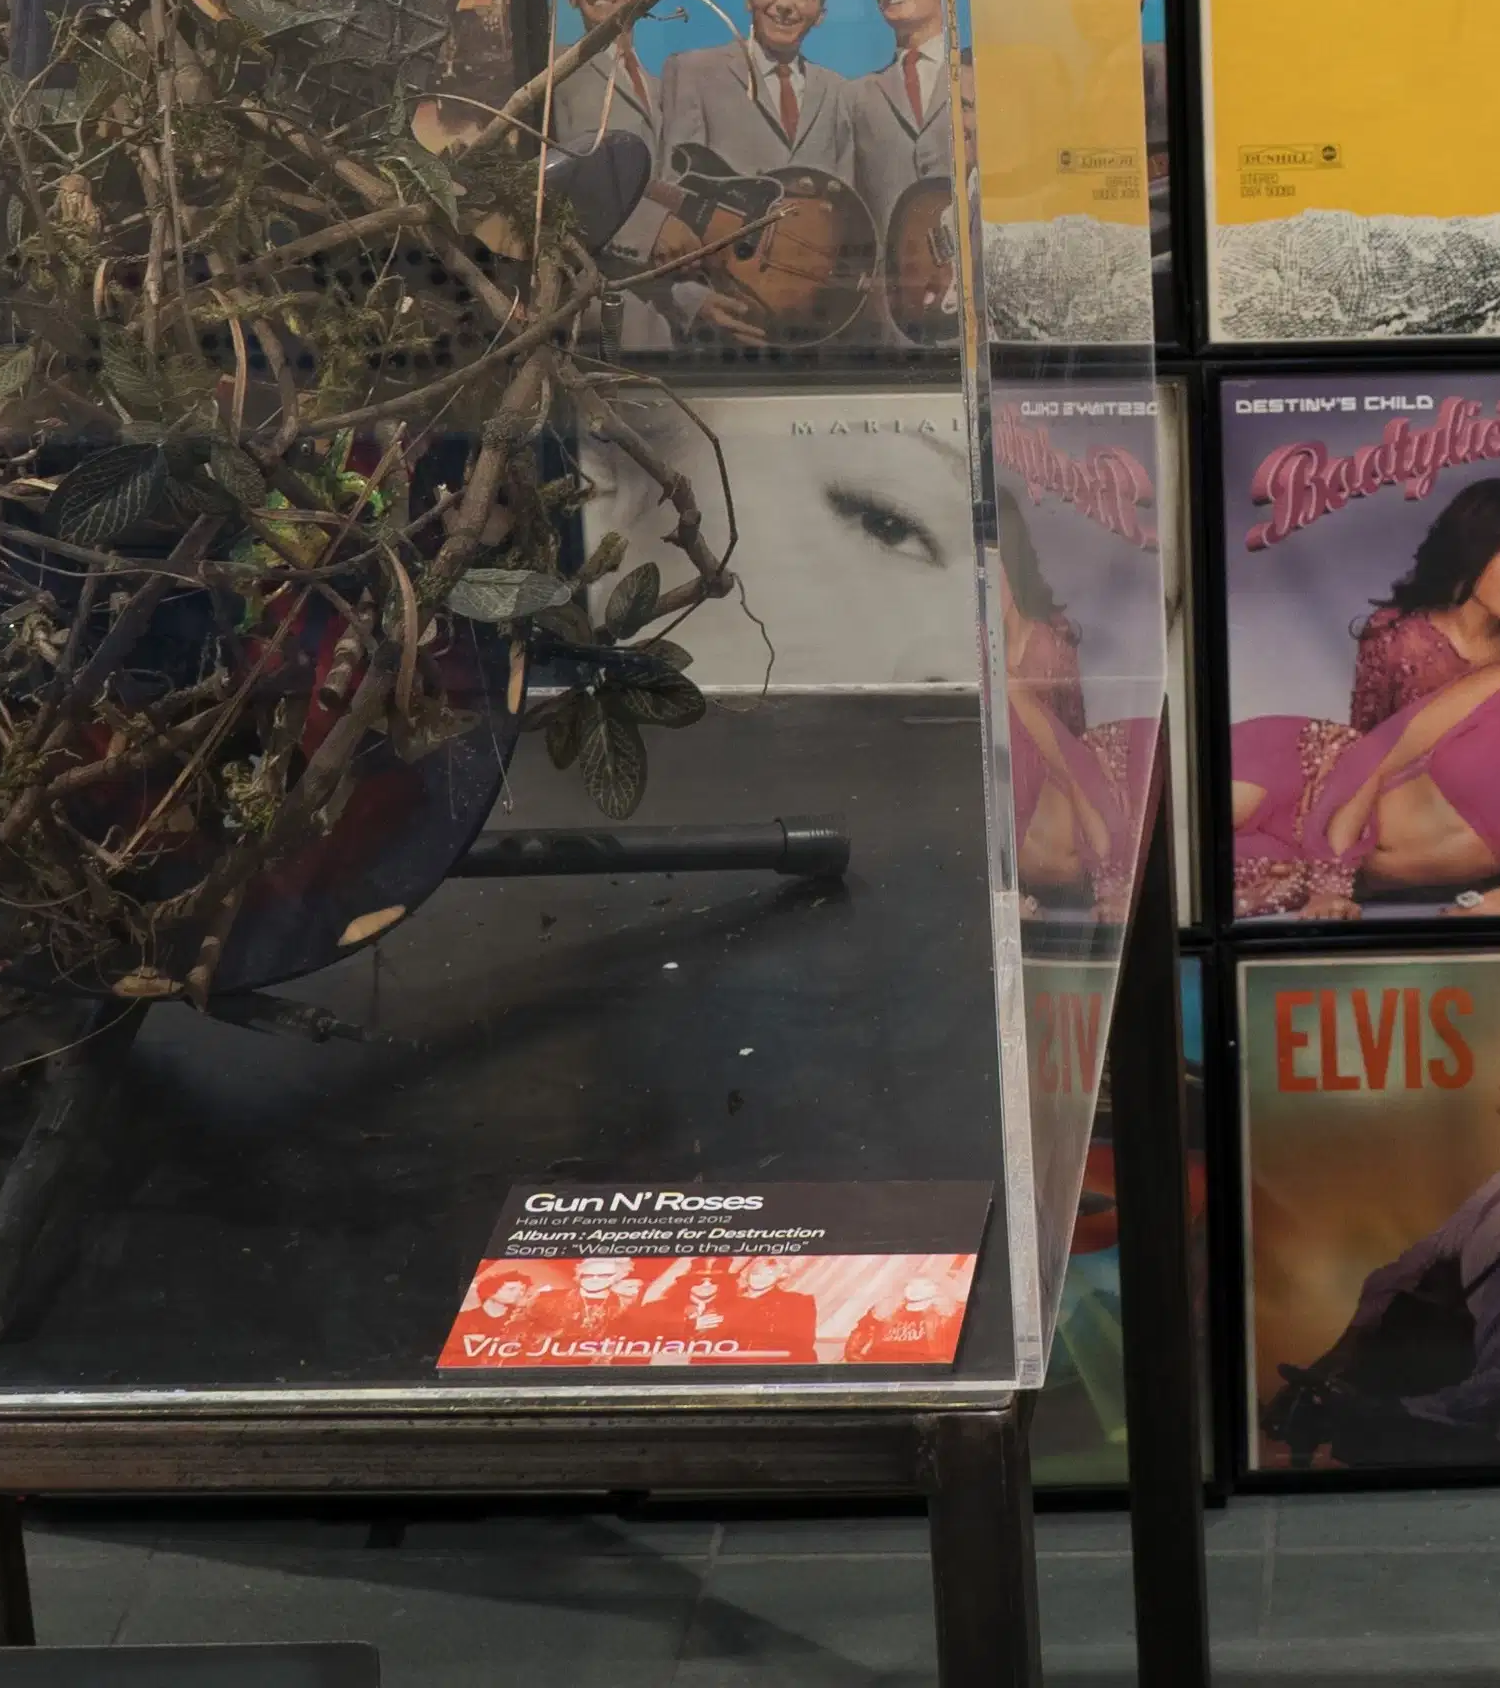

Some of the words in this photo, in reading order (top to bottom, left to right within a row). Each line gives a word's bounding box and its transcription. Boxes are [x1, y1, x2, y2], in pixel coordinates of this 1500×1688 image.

[1235, 396, 1357, 415] DESTINY'S
[1363, 394, 1434, 412] CHILD
[1273, 987, 1475, 1095] ELVIS
[524, 1192, 605, 1213] Gun
[610, 1191, 653, 1212] N'
[655, 1192, 765, 1211] Roses
[515, 1216, 548, 1226] Hall
[551, 1215, 569, 1226] of
[572, 1215, 618, 1226] Fame
[621, 1215, 694, 1225] Inducted
[697, 1215, 733, 1224] 2012
[586, 1228, 673, 1242] Appetite
[676, 1227, 706, 1240] for
[708, 1226, 825, 1240] Destruction
[463, 1334, 521, 1358] Vic
[526, 1335, 739, 1357] Justiniano
